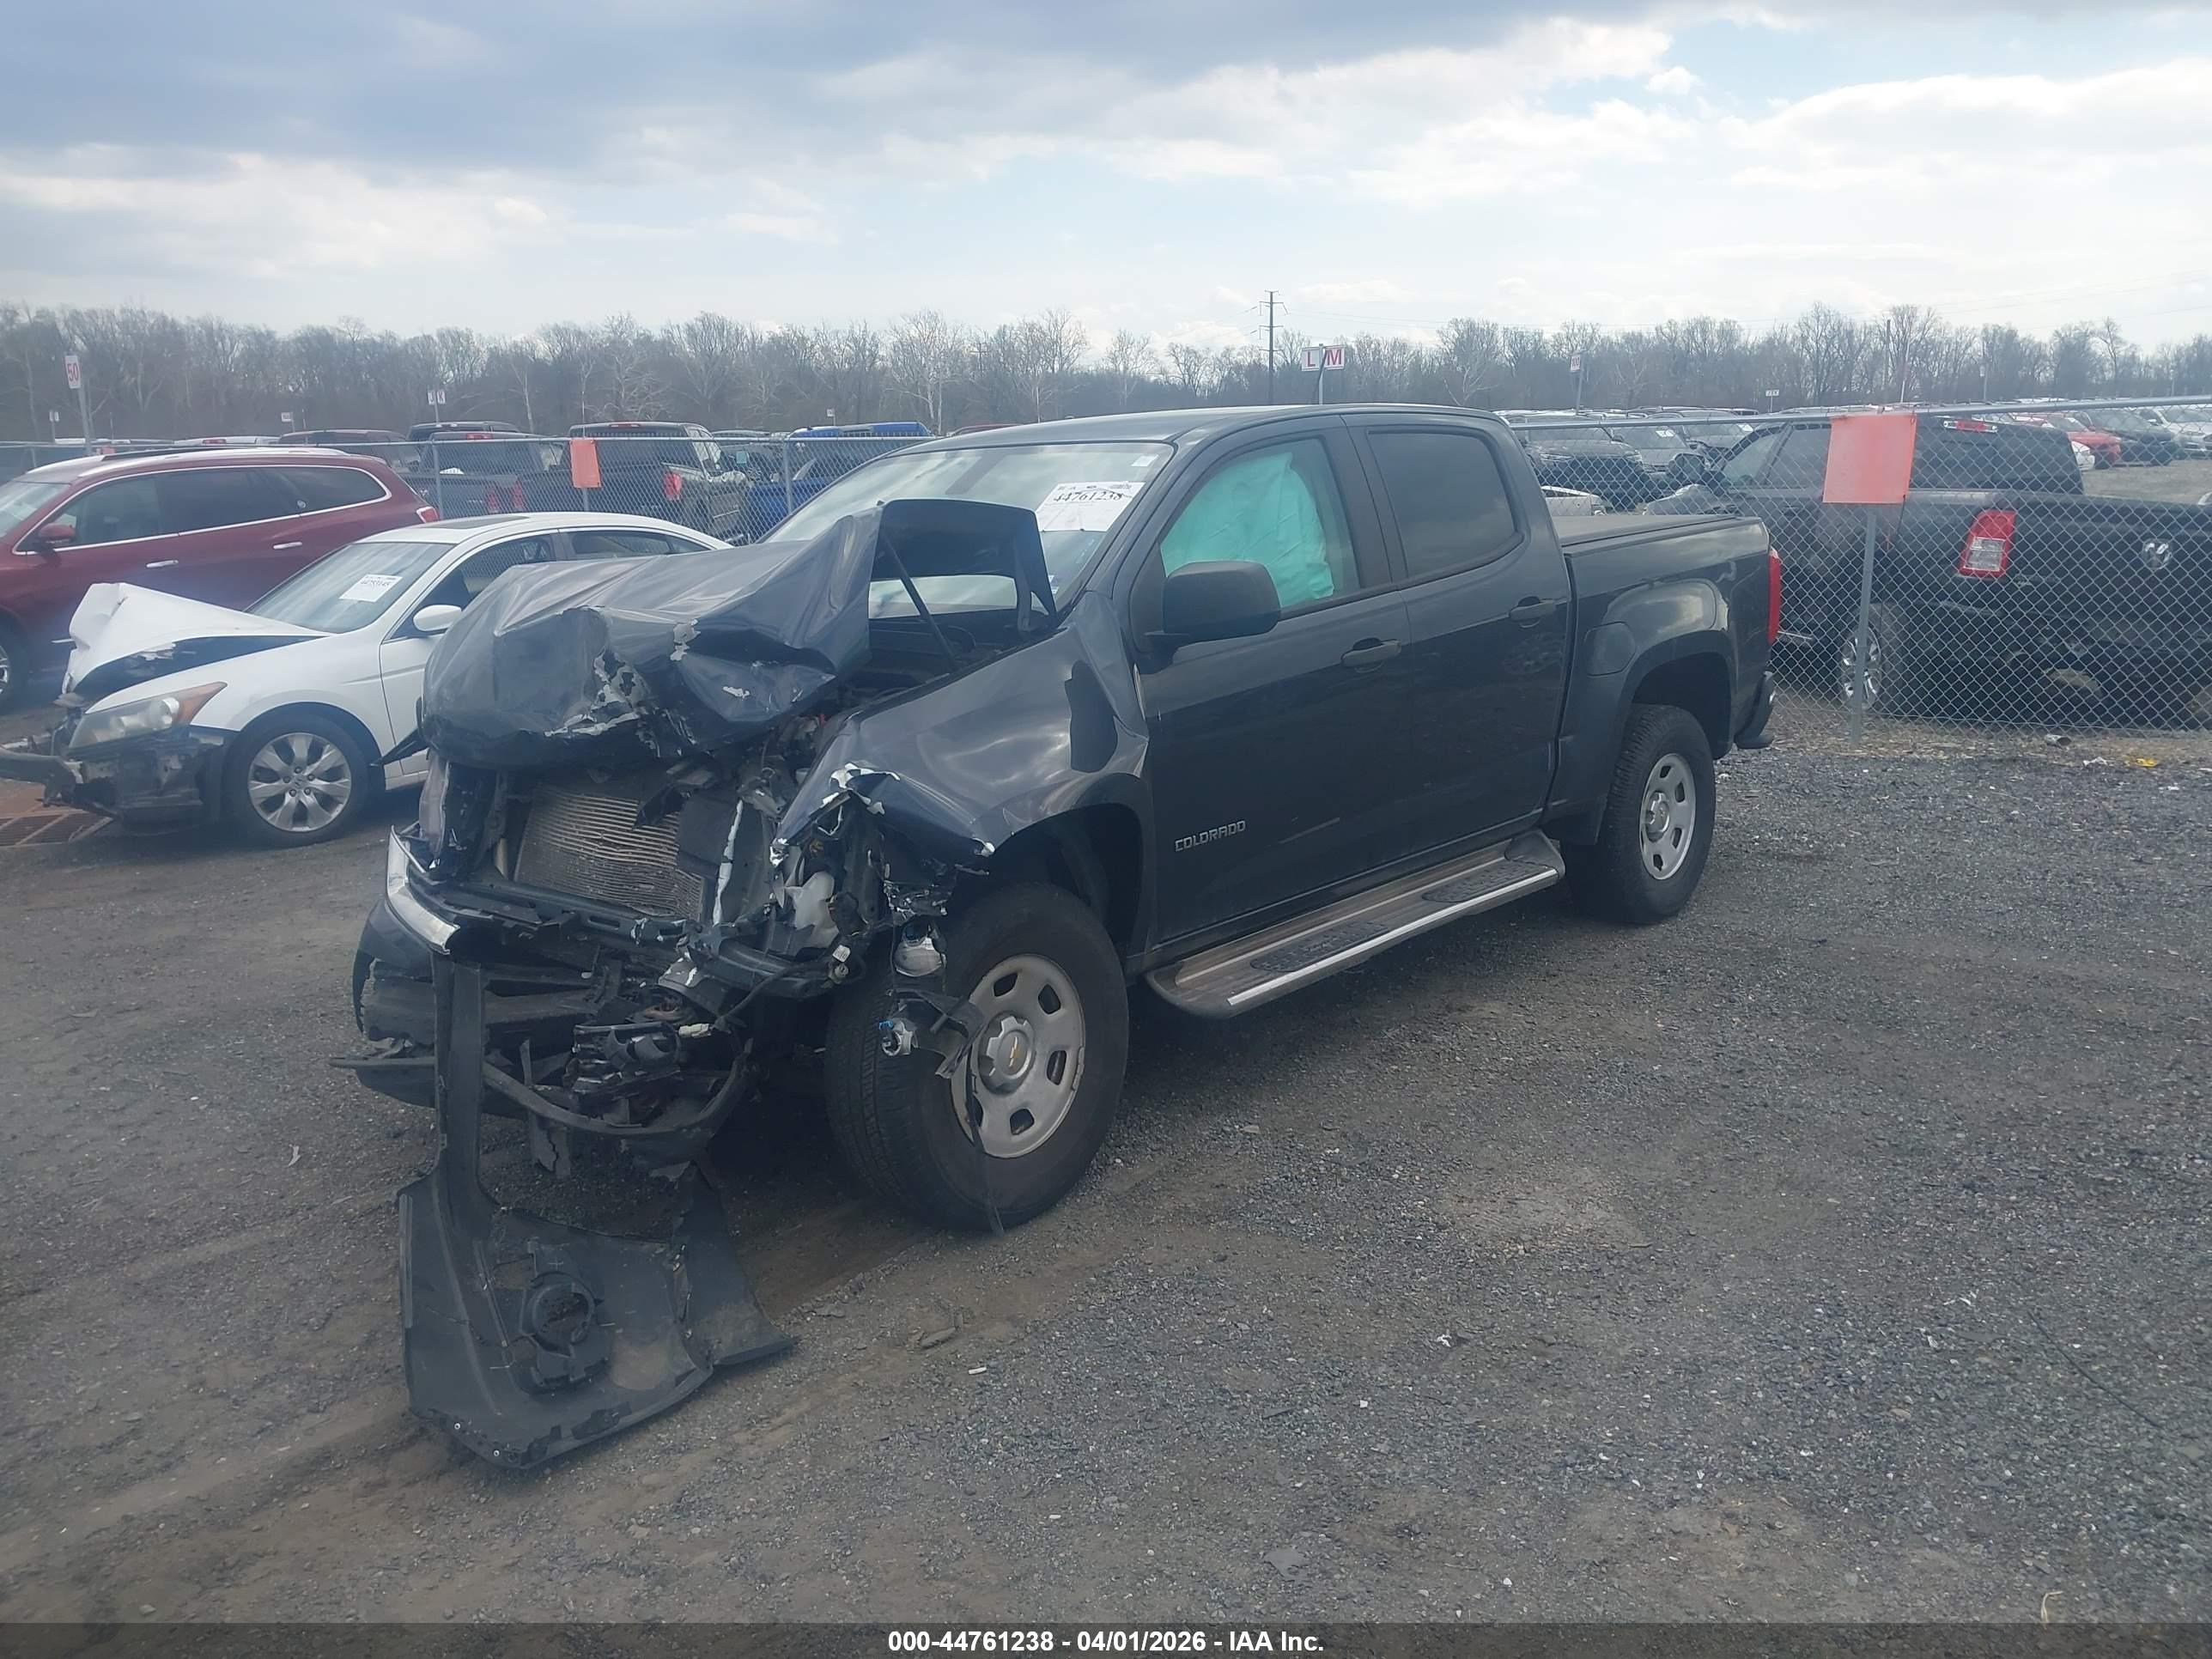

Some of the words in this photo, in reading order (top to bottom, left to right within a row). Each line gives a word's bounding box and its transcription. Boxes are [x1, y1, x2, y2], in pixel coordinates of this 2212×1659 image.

[1307, 350, 1316, 368] L
[1327, 349, 1342, 366] M
[68, 363, 78, 382] 50
[1175, 820, 1246, 852] COLORADO
